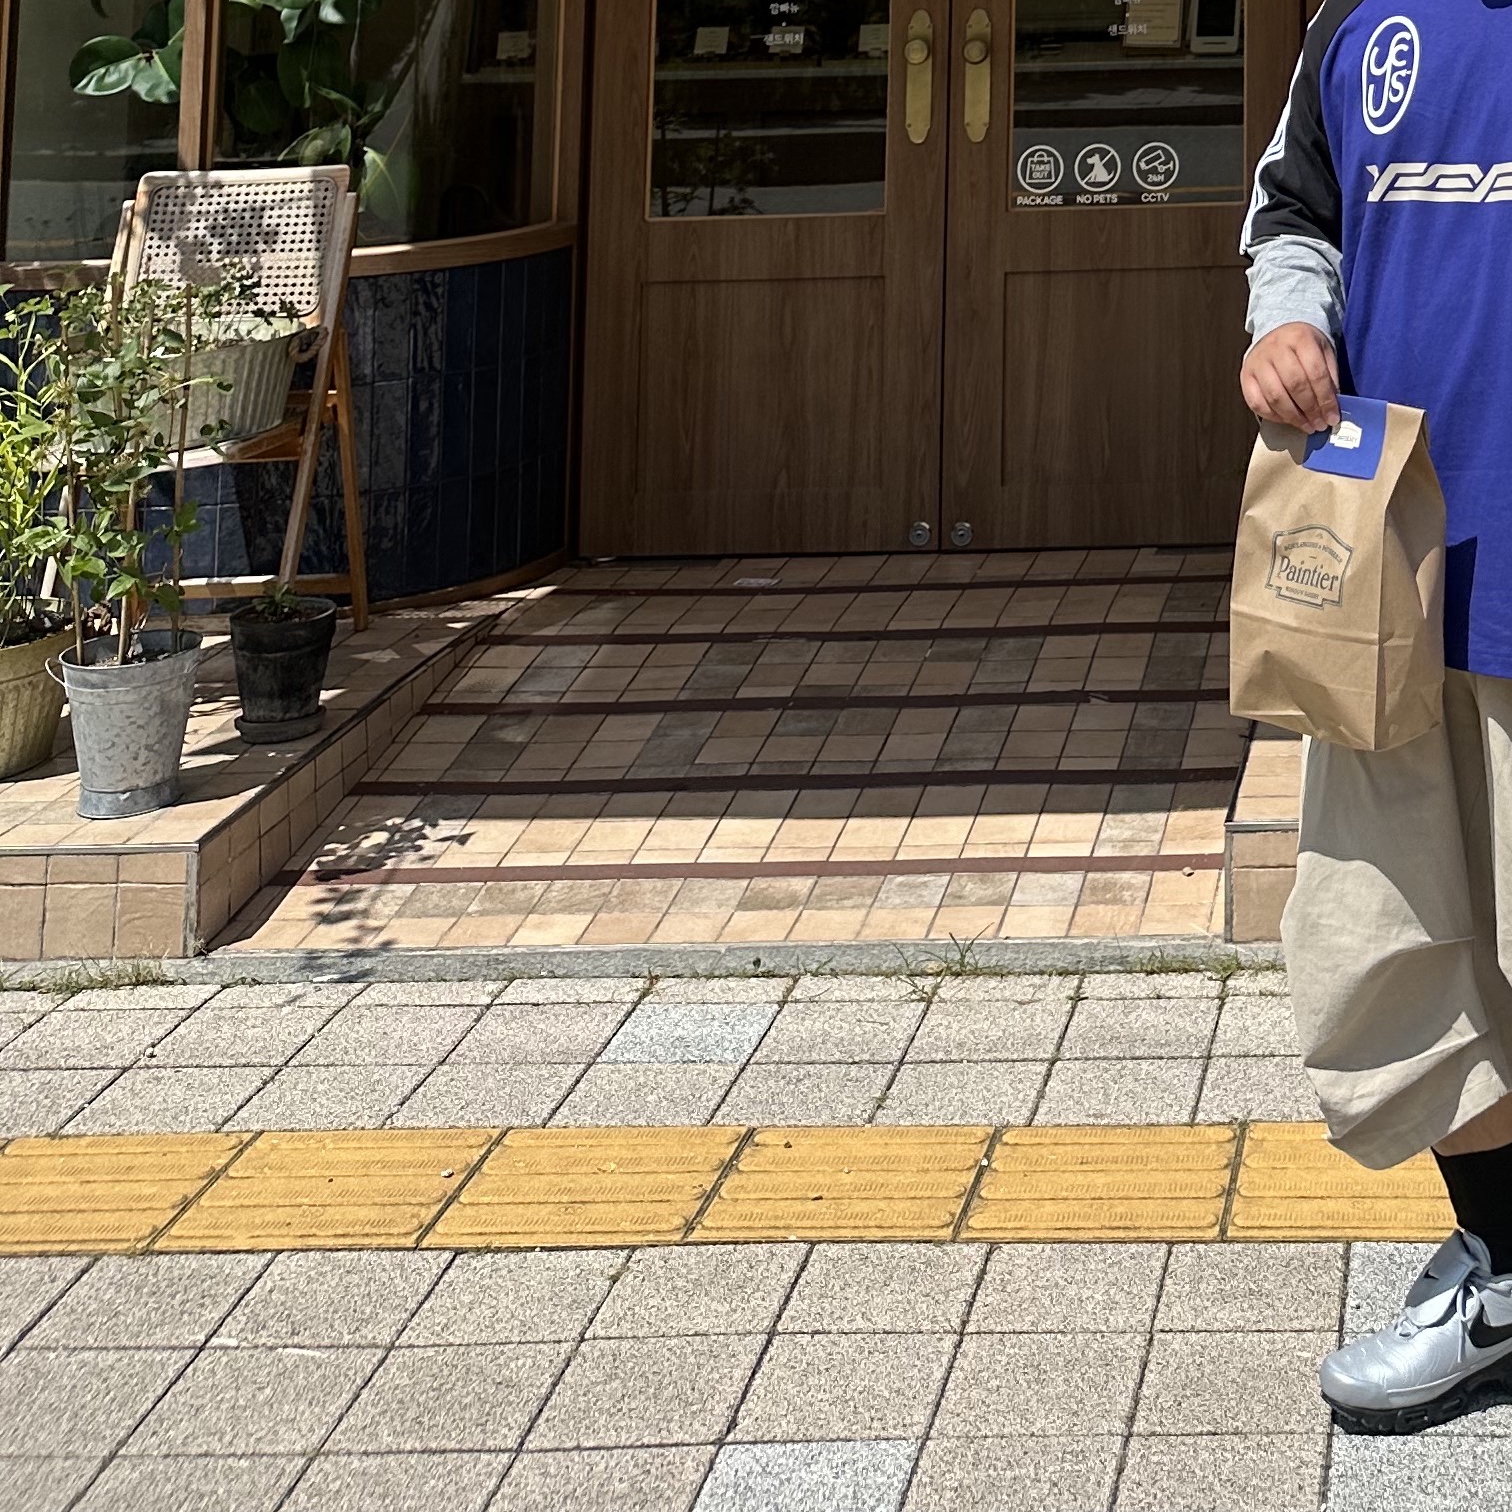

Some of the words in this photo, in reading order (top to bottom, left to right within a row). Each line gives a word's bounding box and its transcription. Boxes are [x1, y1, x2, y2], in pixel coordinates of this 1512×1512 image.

[1030, 163, 1051, 172] TAKE
[1032, 171, 1049, 179] OUT
[1147, 174, 1164, 183] 24H
[1016, 194, 1064, 205] PACKAGE
[1076, 194, 1091, 204] NO
[1093, 193, 1118, 203] PETS
[1141, 192, 1170, 203] CCTV
[1276, 556, 1338, 591] Paintier
